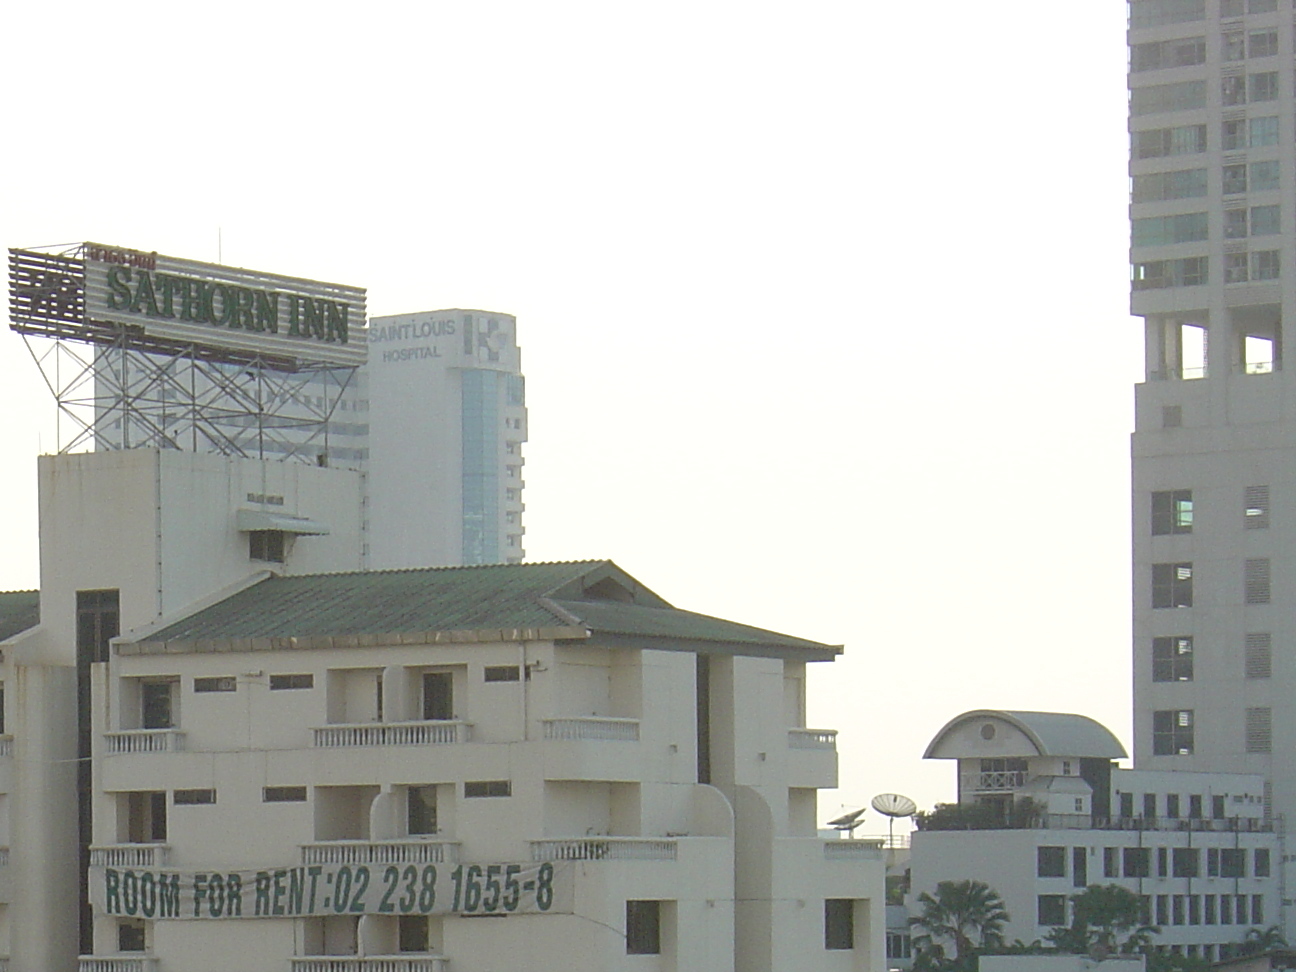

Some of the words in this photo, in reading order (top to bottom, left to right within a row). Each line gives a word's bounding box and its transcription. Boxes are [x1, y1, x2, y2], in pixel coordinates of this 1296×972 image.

[107, 266, 279, 334] SATHORN
[287, 294, 350, 344] INN
[382, 346, 442, 363] HOSPITAL
[106, 867, 180, 918] ROOM
[194, 872, 242, 918] FOR
[378, 864, 437, 914] 238
[450, 862, 554, 913] 1655-8
